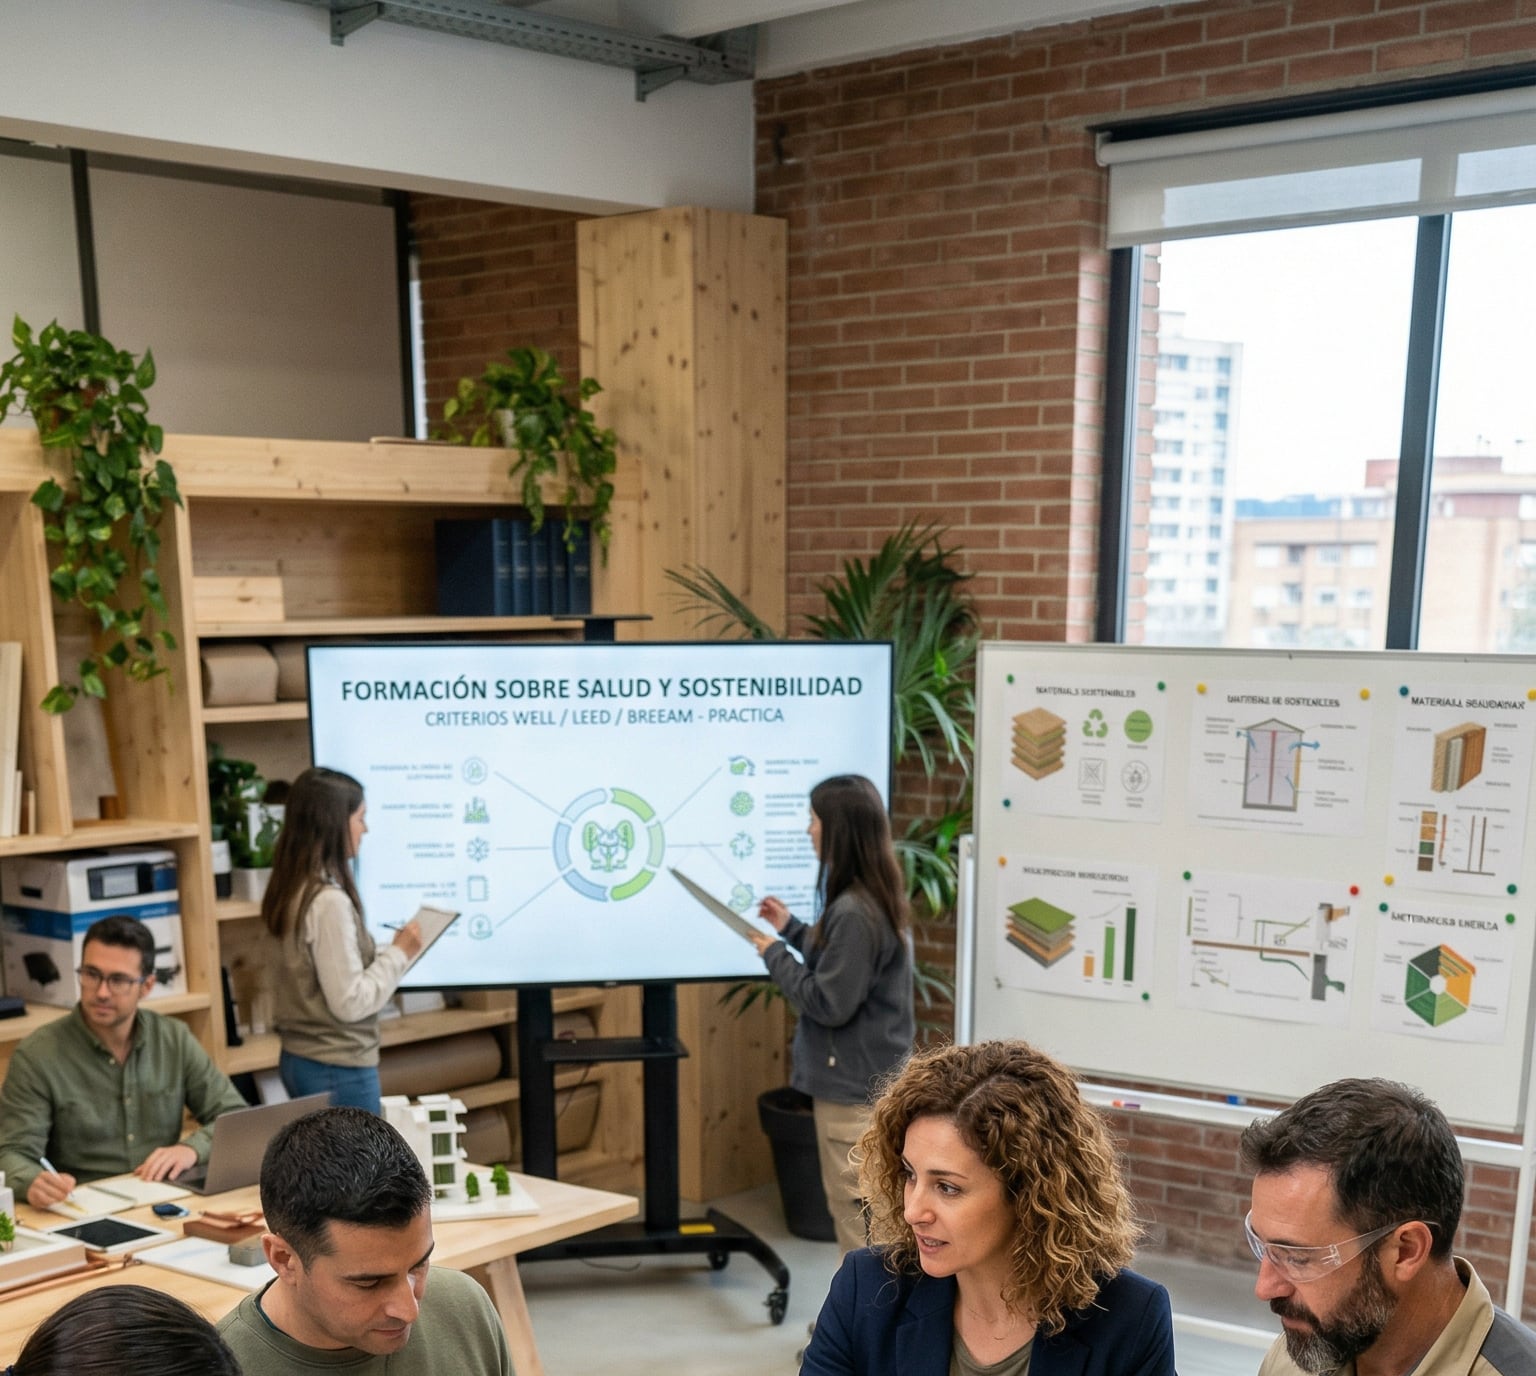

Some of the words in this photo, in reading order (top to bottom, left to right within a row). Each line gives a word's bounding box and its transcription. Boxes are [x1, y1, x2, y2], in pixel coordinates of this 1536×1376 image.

[342, 674, 487, 700] FORMACIÓN
[495, 679, 570, 699] SOBRE
[578, 678, 651, 698] SALUD
[659, 678, 672, 697] Y
[679, 677, 863, 697] SOSTENIBILIDAD
[425, 710, 508, 727] CRITERIOS
[513, 711, 556, 725] WELL
[572, 710, 611, 725] LEED
[628, 709, 693, 724] BREEAM
[709, 708, 784, 723] PRACTICA
